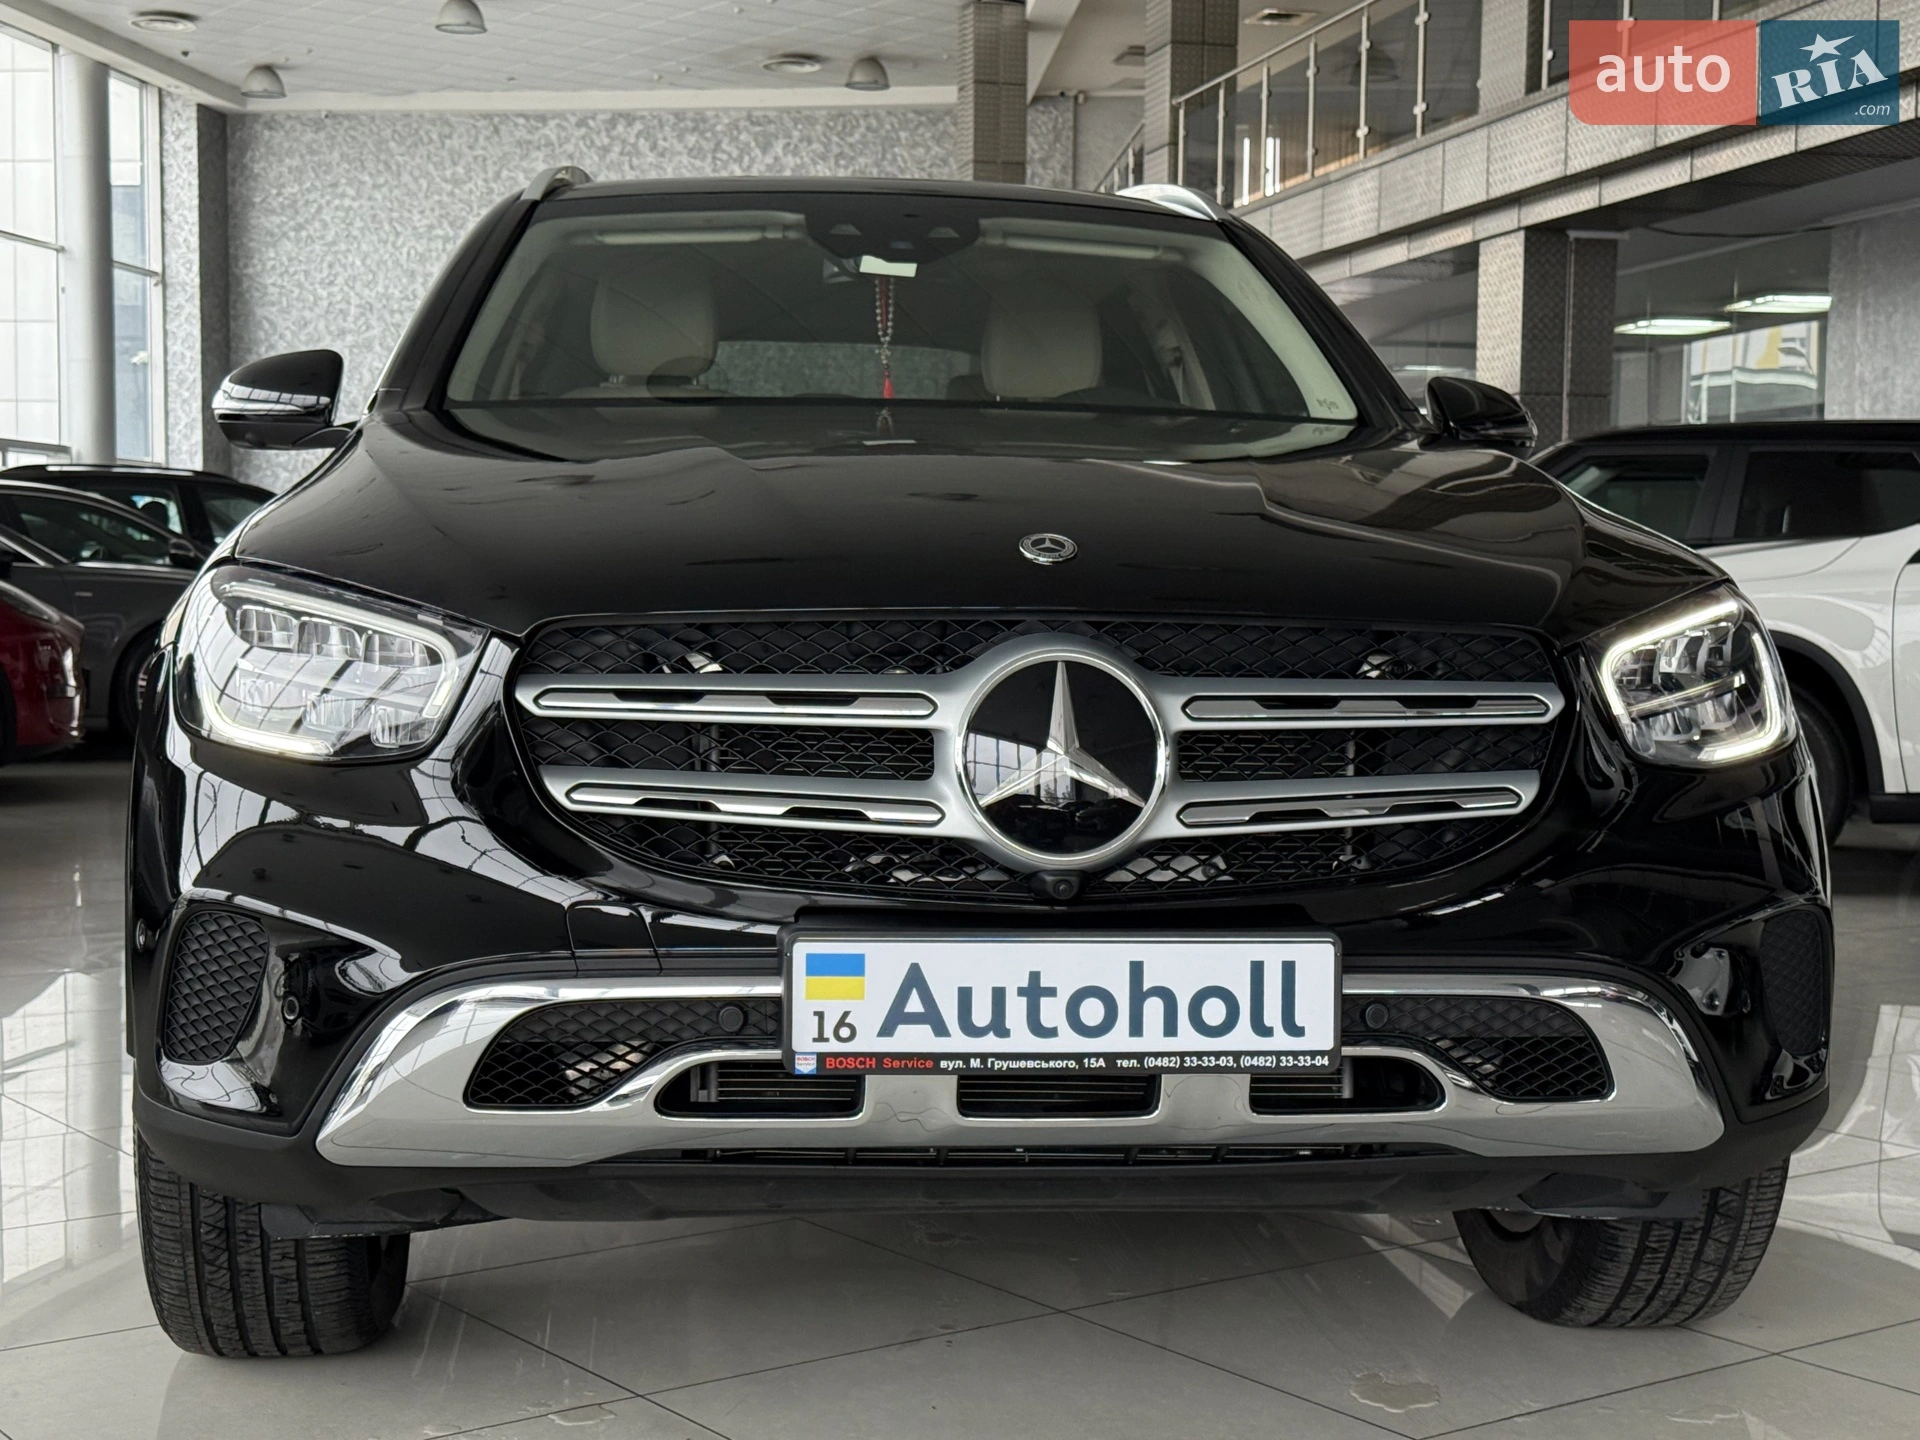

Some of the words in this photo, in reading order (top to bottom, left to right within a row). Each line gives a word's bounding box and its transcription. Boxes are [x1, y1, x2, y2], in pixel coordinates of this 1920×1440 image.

[812, 1010, 857, 1044] 16
[876, 960, 1306, 1039] Autoholl
[825, 1057, 876, 1069] BOSCH
[882, 1057, 934, 1068] Service
[939, 1058, 966, 1071] вул.
[987, 1057, 1079, 1071] Грушевського,
[1115, 1058, 1141, 1068] тел.
[1143, 1055, 1181, 1069] (0482)
[1183, 1056, 1237, 1069] 33-33-03,
[1240, 1055, 1277, 1068] (0482)
[1279, 1056, 1330, 1067] 33-33-04
